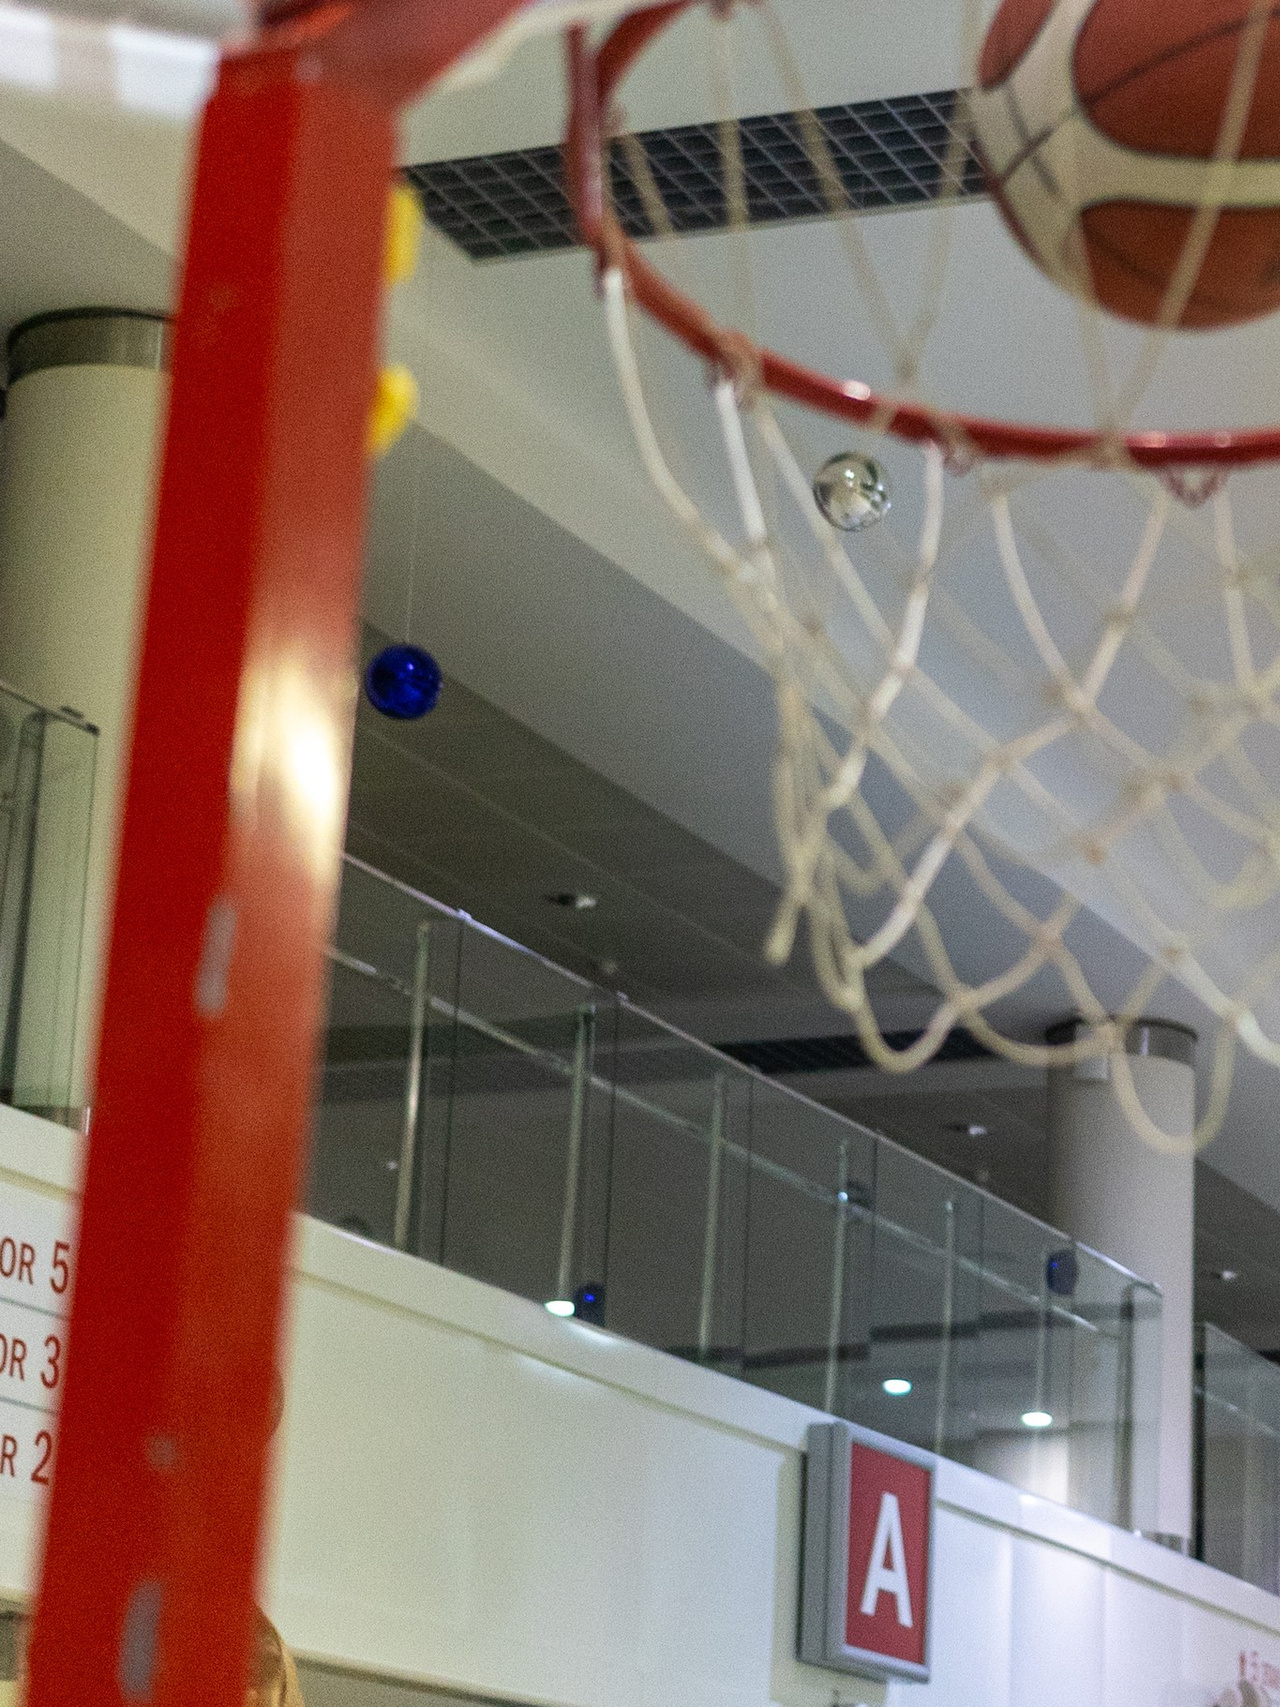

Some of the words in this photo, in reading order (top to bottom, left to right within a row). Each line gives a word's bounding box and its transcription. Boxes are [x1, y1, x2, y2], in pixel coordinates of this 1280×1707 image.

[51, 1241, 70, 1294] 5
[41, 1335, 61, 1389] 3
[31, 1431, 53, 1485] 2
[860, 1491, 914, 1629] A
